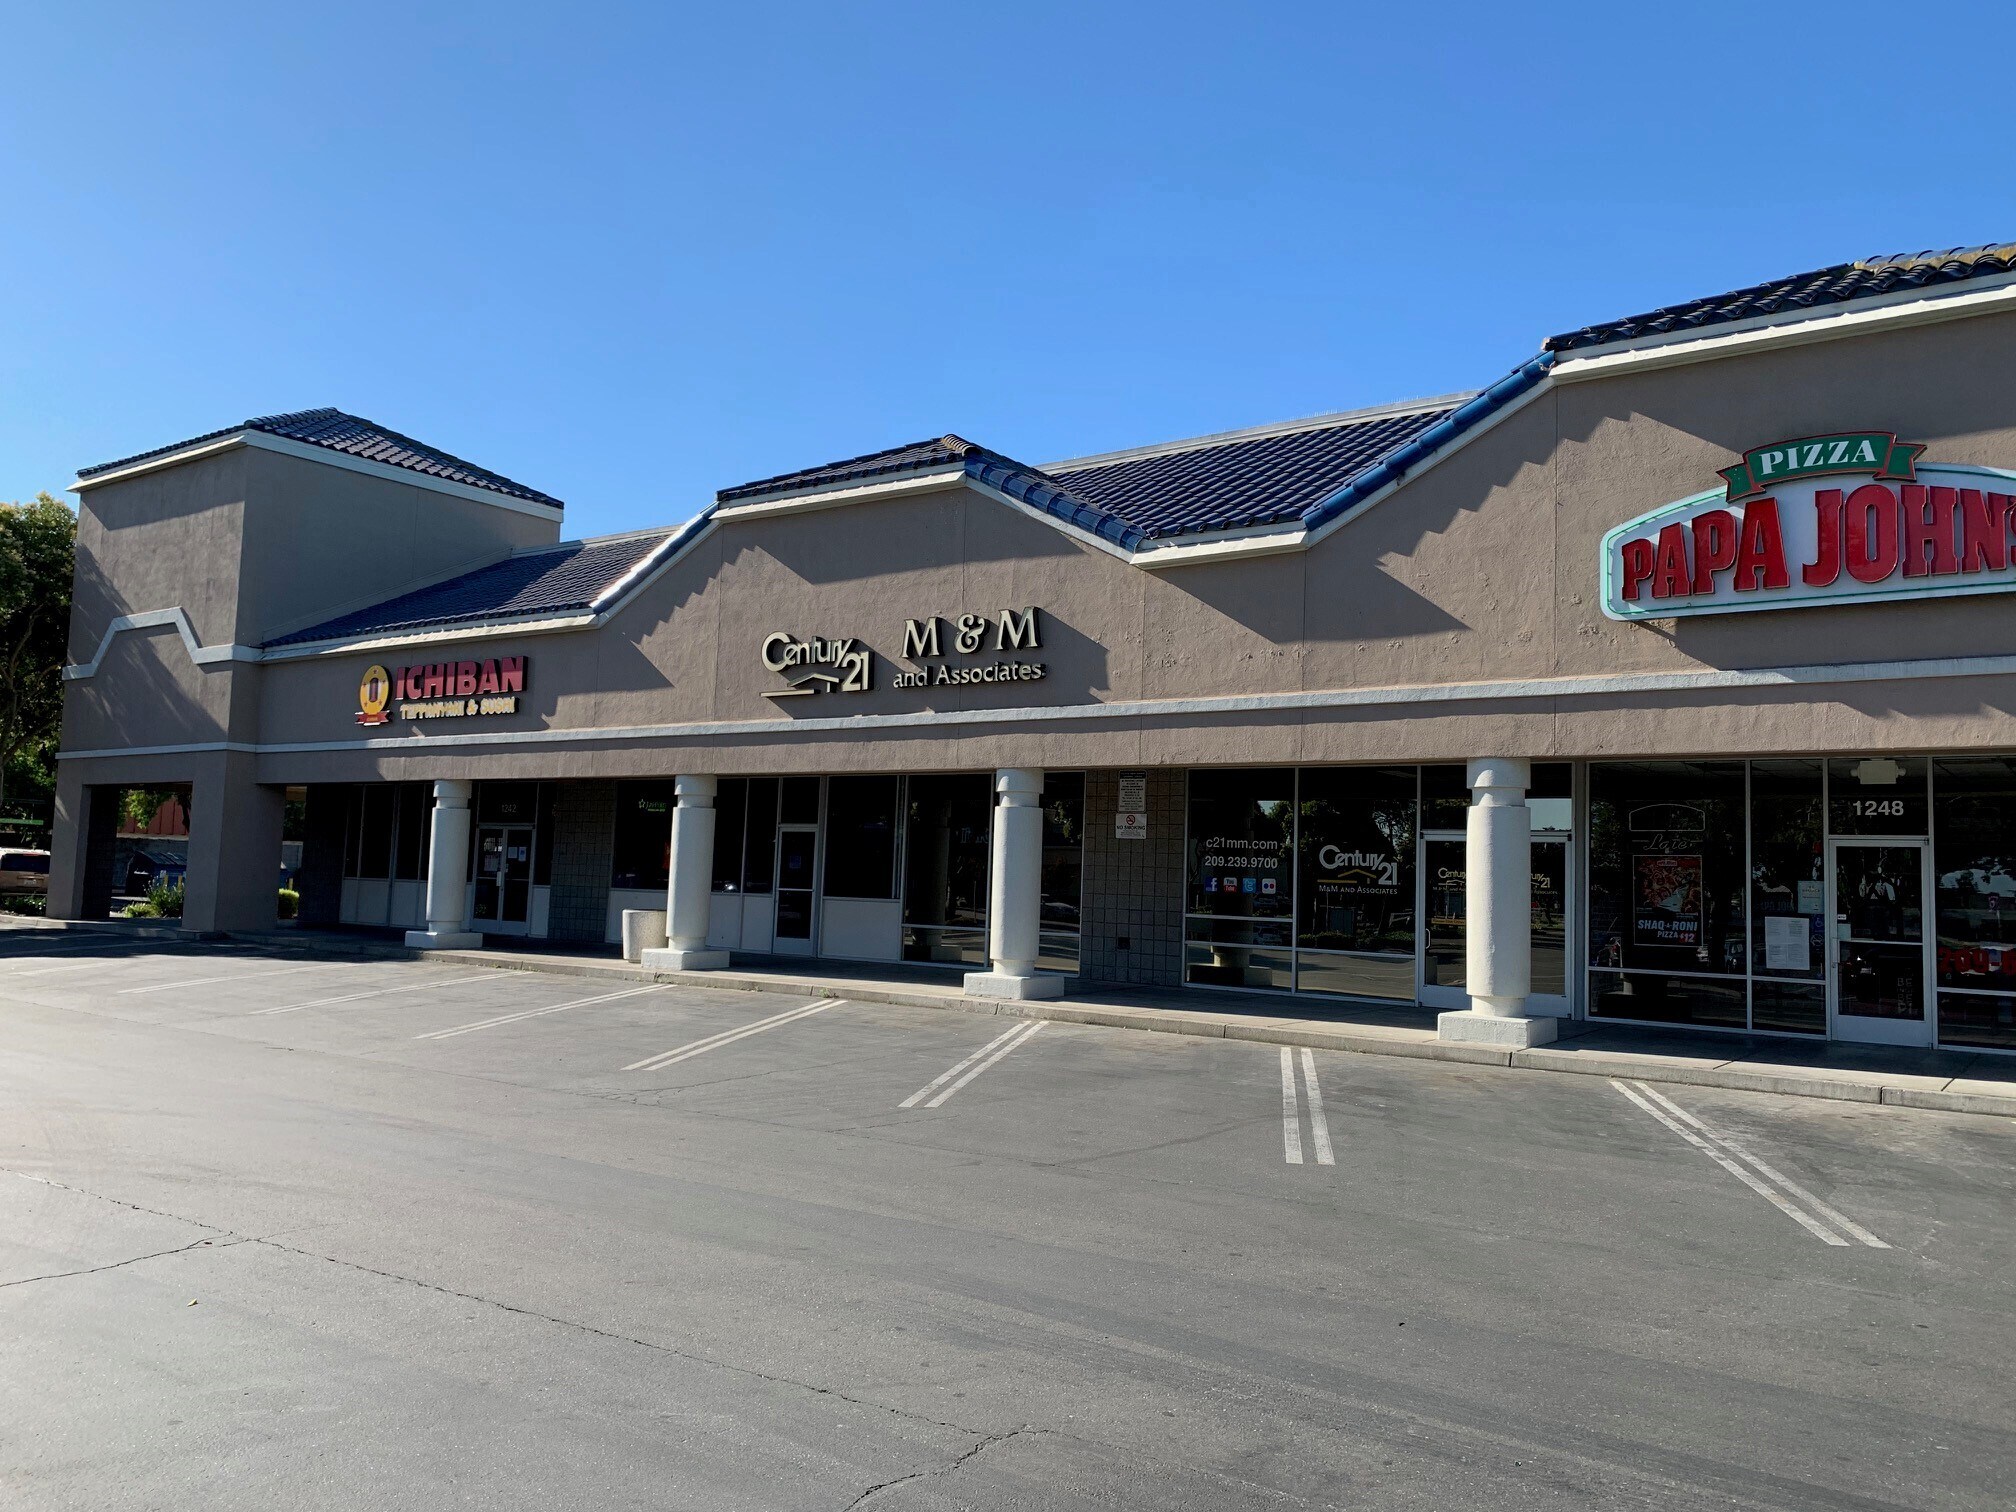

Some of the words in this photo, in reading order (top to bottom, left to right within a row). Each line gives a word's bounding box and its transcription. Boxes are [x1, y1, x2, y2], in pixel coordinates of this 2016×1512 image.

[1758, 439, 1878, 476] PIZZA
[1620, 496, 1791, 600] PAPA
[901, 617, 941, 659] M
[954, 613, 986, 654] &
[996, 606, 1041, 651] M
[761, 631, 858, 672] Century
[395, 655, 526, 700] ICHIBAN
[841, 650, 874, 692] 21
[893, 665, 929, 688] and
[934, 660, 1043, 685] Associates
[466, 698, 479, 716] &
[480, 696, 516, 715] SUSHI
[1852, 799, 1905, 817] 1248
[1205, 836, 1278, 850] c21mm.com
[1204, 855, 1279, 870] 209.239.9700
[1319, 844, 1386, 870] Century
[1377, 861, 1398, 886] 21
[1657, 930, 1679, 939] PIZZA
